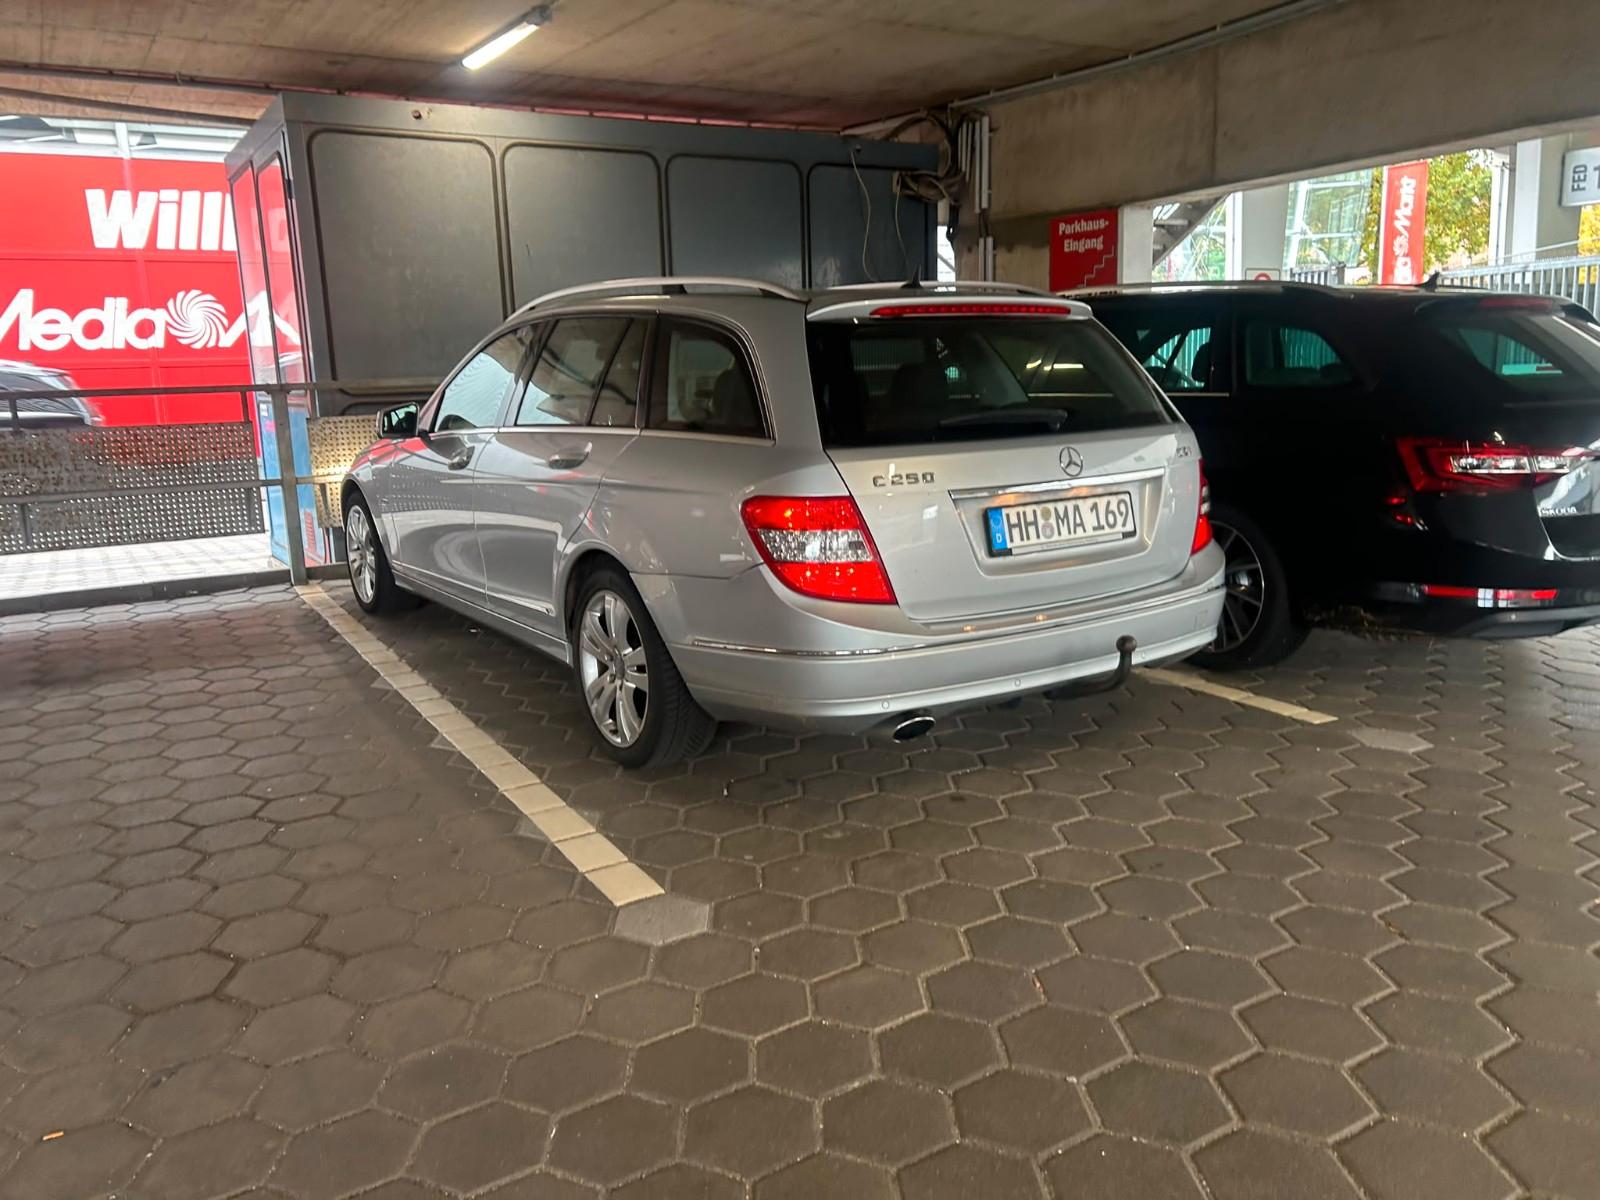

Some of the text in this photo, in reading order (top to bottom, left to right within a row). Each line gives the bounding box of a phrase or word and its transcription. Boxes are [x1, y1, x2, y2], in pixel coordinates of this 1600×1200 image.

[1571, 164, 1587, 192] FED
[1059, 218, 1109, 235] Parkhaus-
[1063, 234, 1104, 253] Eingang
[890, 471, 935, 486] 250
[1005, 498, 1130, 543] HH MA 169
